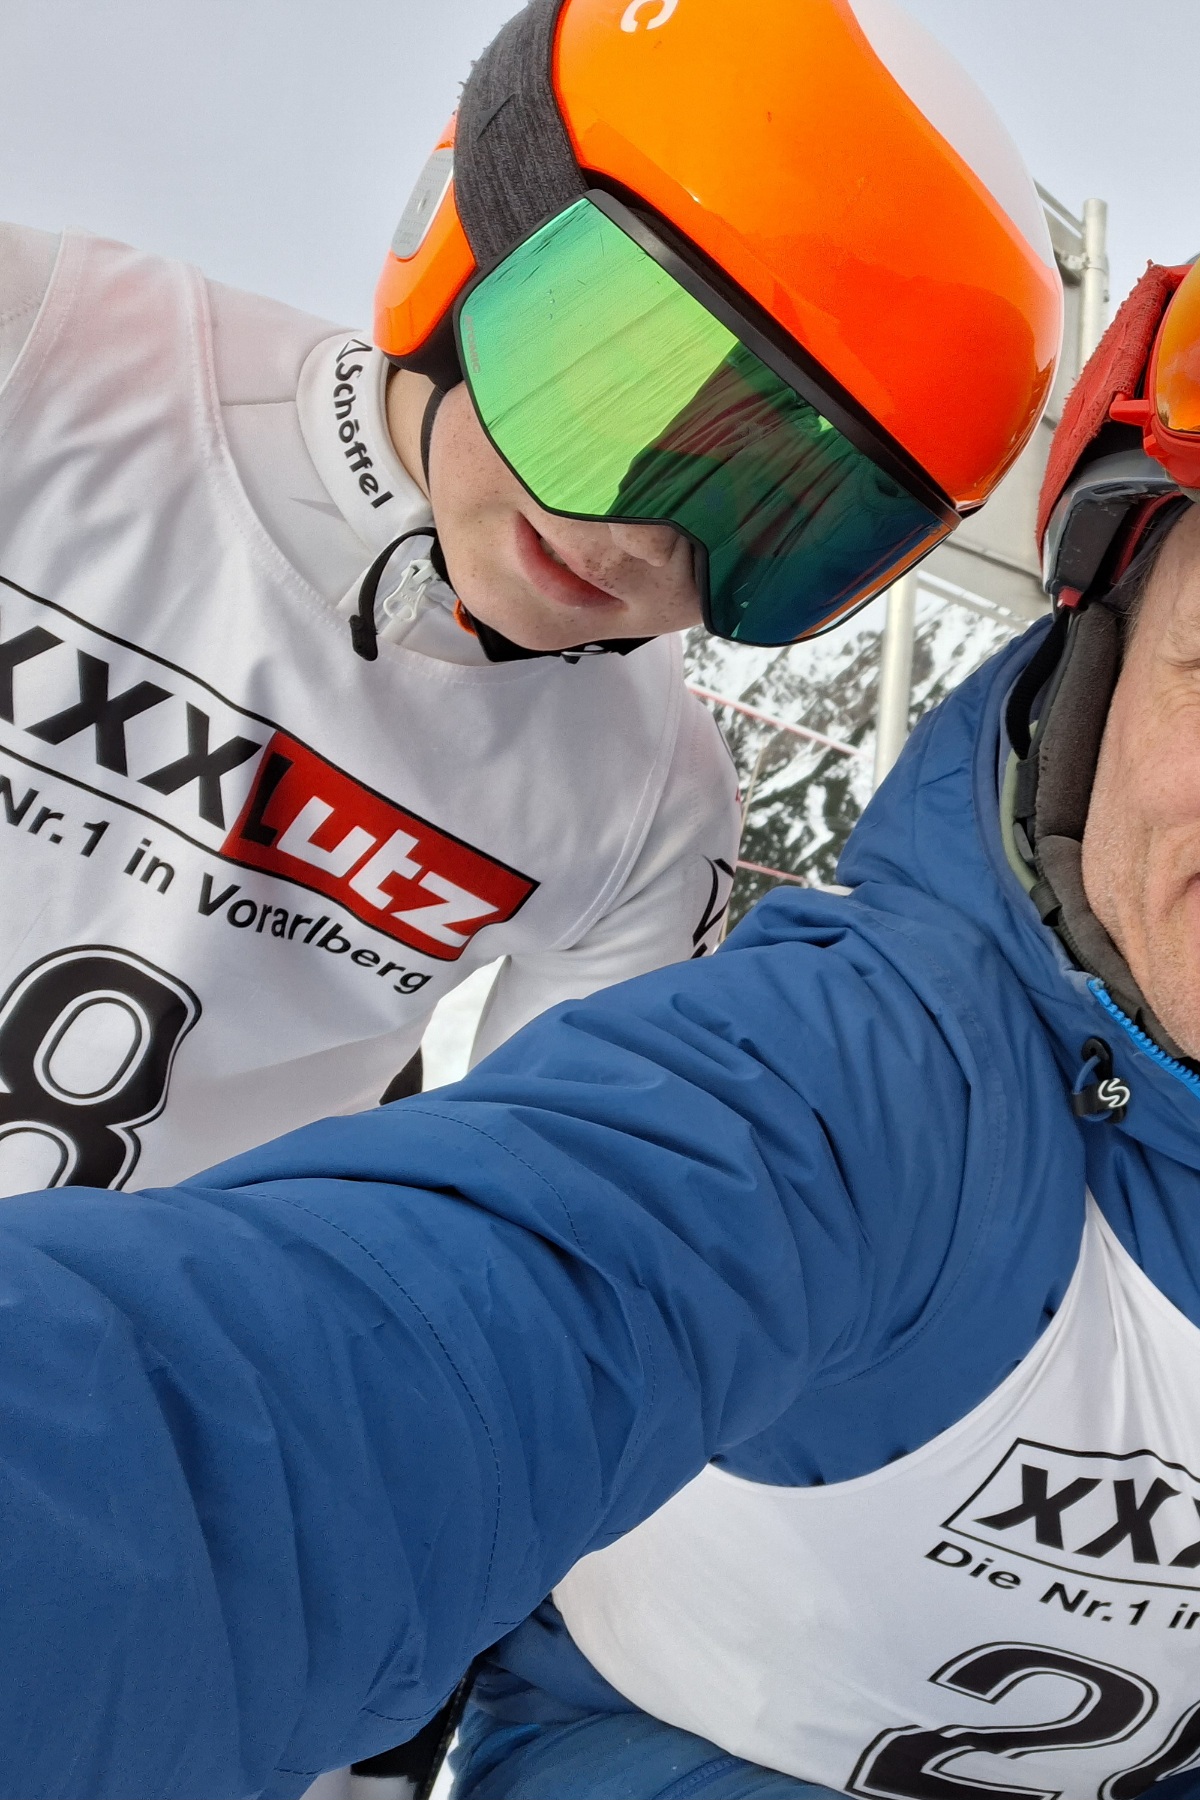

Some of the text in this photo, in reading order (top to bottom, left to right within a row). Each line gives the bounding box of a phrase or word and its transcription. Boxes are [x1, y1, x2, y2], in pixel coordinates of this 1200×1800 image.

[123, 837, 175, 895] in
[198, 872, 433, 995] Vorarlberg
[924, 1540, 1021, 1590] Die
[1039, 1582, 1151, 1626] Nr.1
